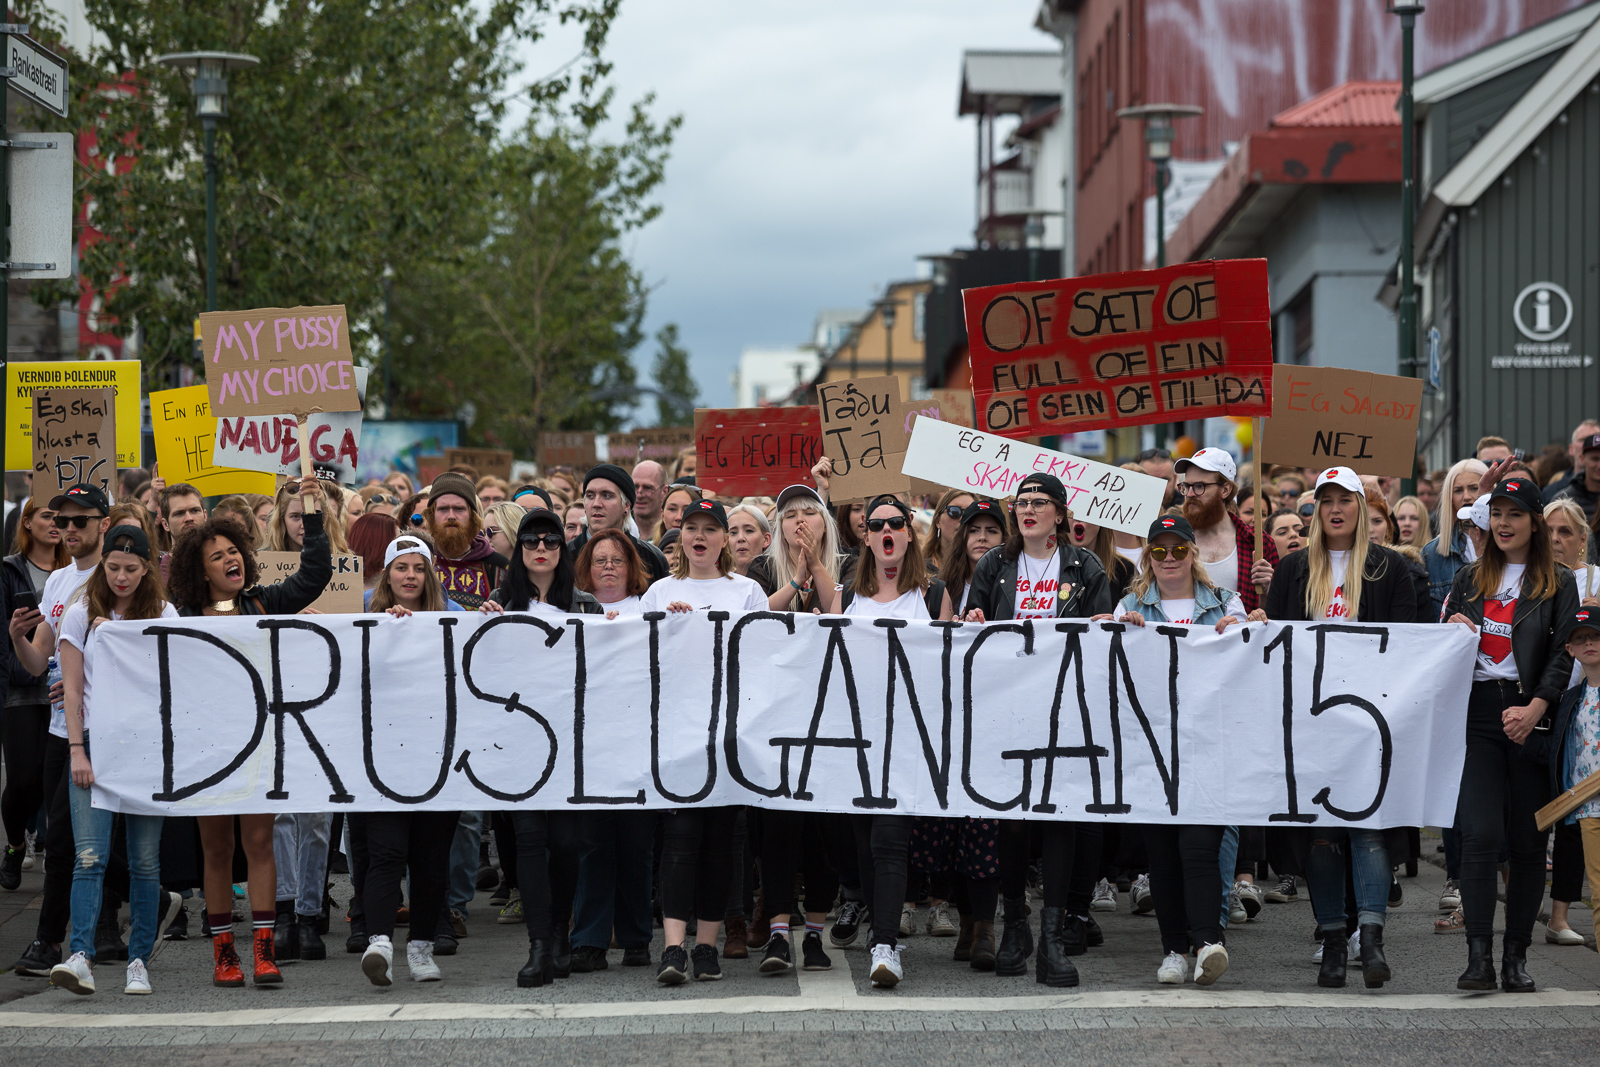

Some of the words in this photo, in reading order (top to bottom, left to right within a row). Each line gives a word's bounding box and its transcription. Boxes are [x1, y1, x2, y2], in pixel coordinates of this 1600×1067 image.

[12, 47, 57, 96] Bankastræti
[213, 319, 264, 363] MY
[274, 314, 343, 353] PUSSY
[982, 291, 1055, 352] OF
[1070, 290, 1155, 337] SÆT
[1166, 280, 1217, 321] OF
[18, 370, 62, 383] VERNDIÐ
[64, 369, 117, 382] ÞOLENDUR
[218, 369, 260, 405] MY
[263, 360, 352, 396] CHOICE
[993, 361, 1079, 393] FULL
[1095, 351, 1147, 379] OF
[1160, 341, 1225, 373] EIN
[1491, 356, 1582, 368] INFORMATION
[986, 398, 1029, 430] OF
[1041, 391, 1105, 420] SEIN
[1116, 385, 1152, 414] OF
[1311, 430, 1374, 459] NEI
[313, 466, 336, 480] ÉR
[1482, 619, 1512, 637] RUSL
[142, 611, 1190, 816] DRUSLUGANGAN
[1242, 623, 1390, 823] '15
